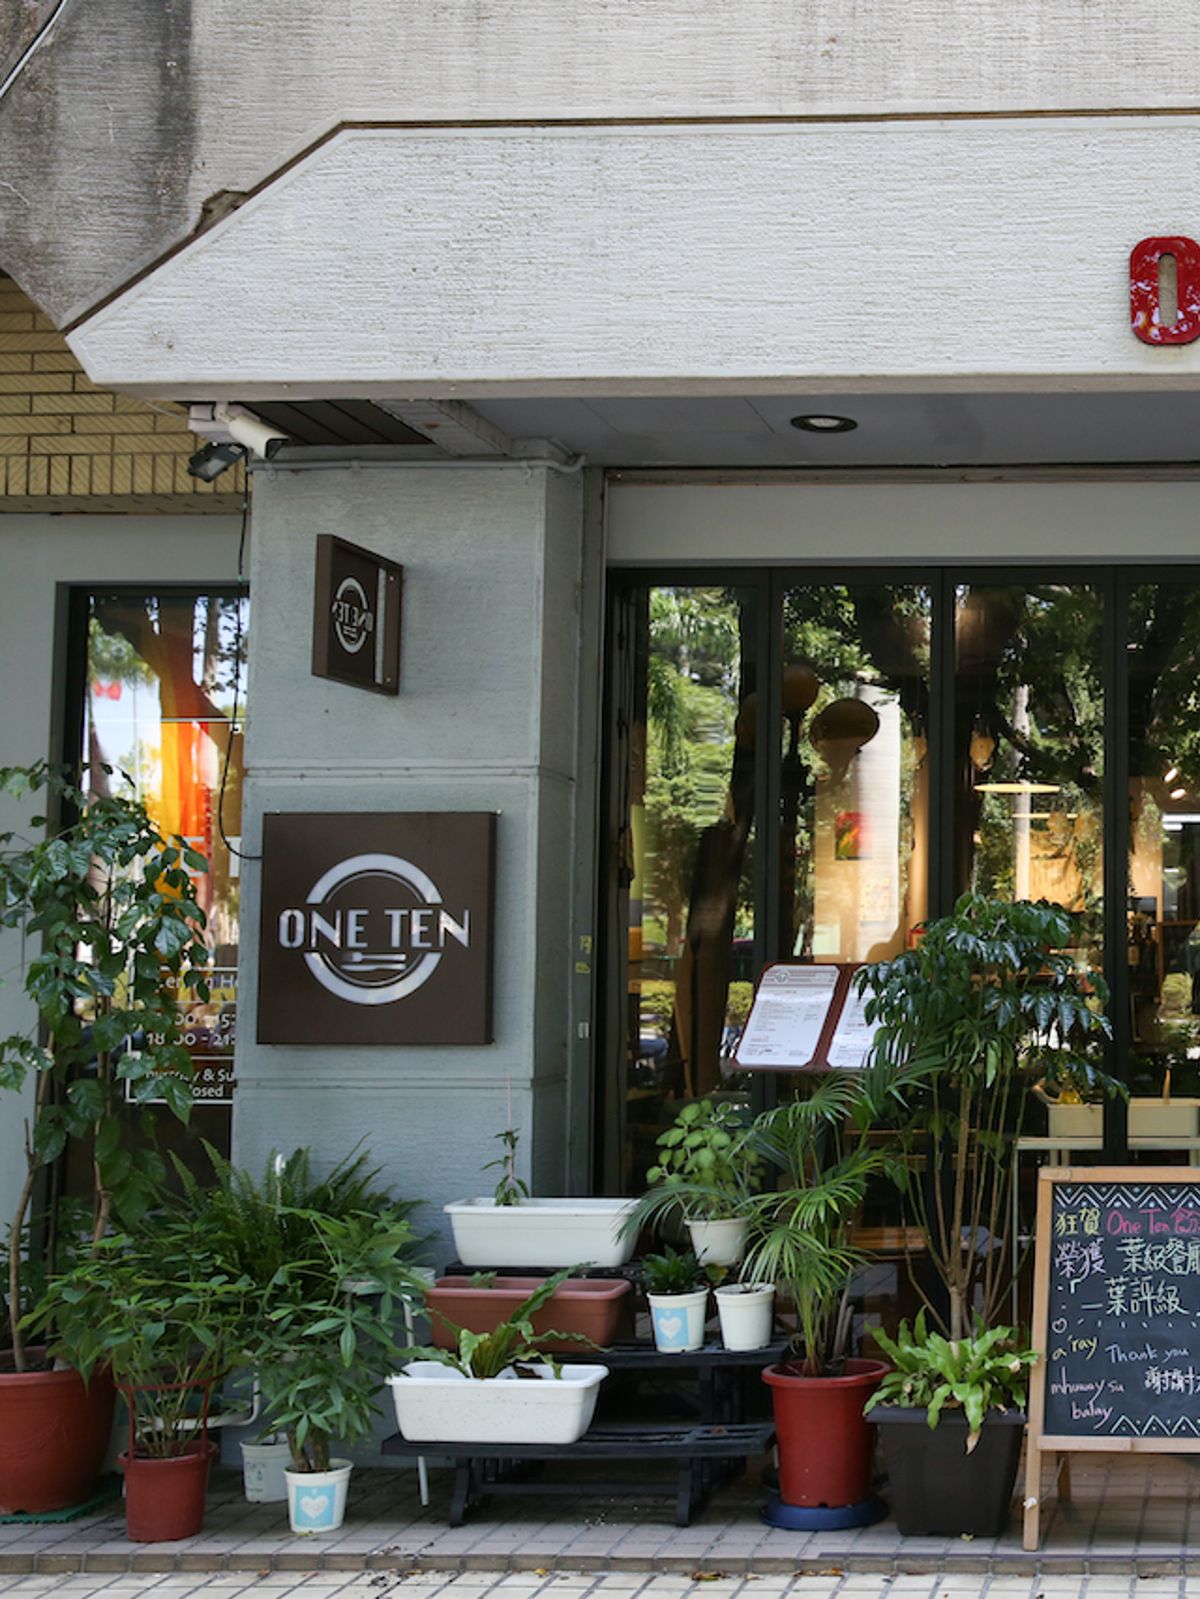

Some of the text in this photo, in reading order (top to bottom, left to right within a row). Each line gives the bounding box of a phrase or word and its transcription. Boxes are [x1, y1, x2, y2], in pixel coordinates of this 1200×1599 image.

[279, 908, 469, 948] ONE TEN
[1107, 1210, 1141, 1235] One
[1139, 1207, 1170, 1234] Ten
[1105, 1343, 1190, 1363] Thank you
